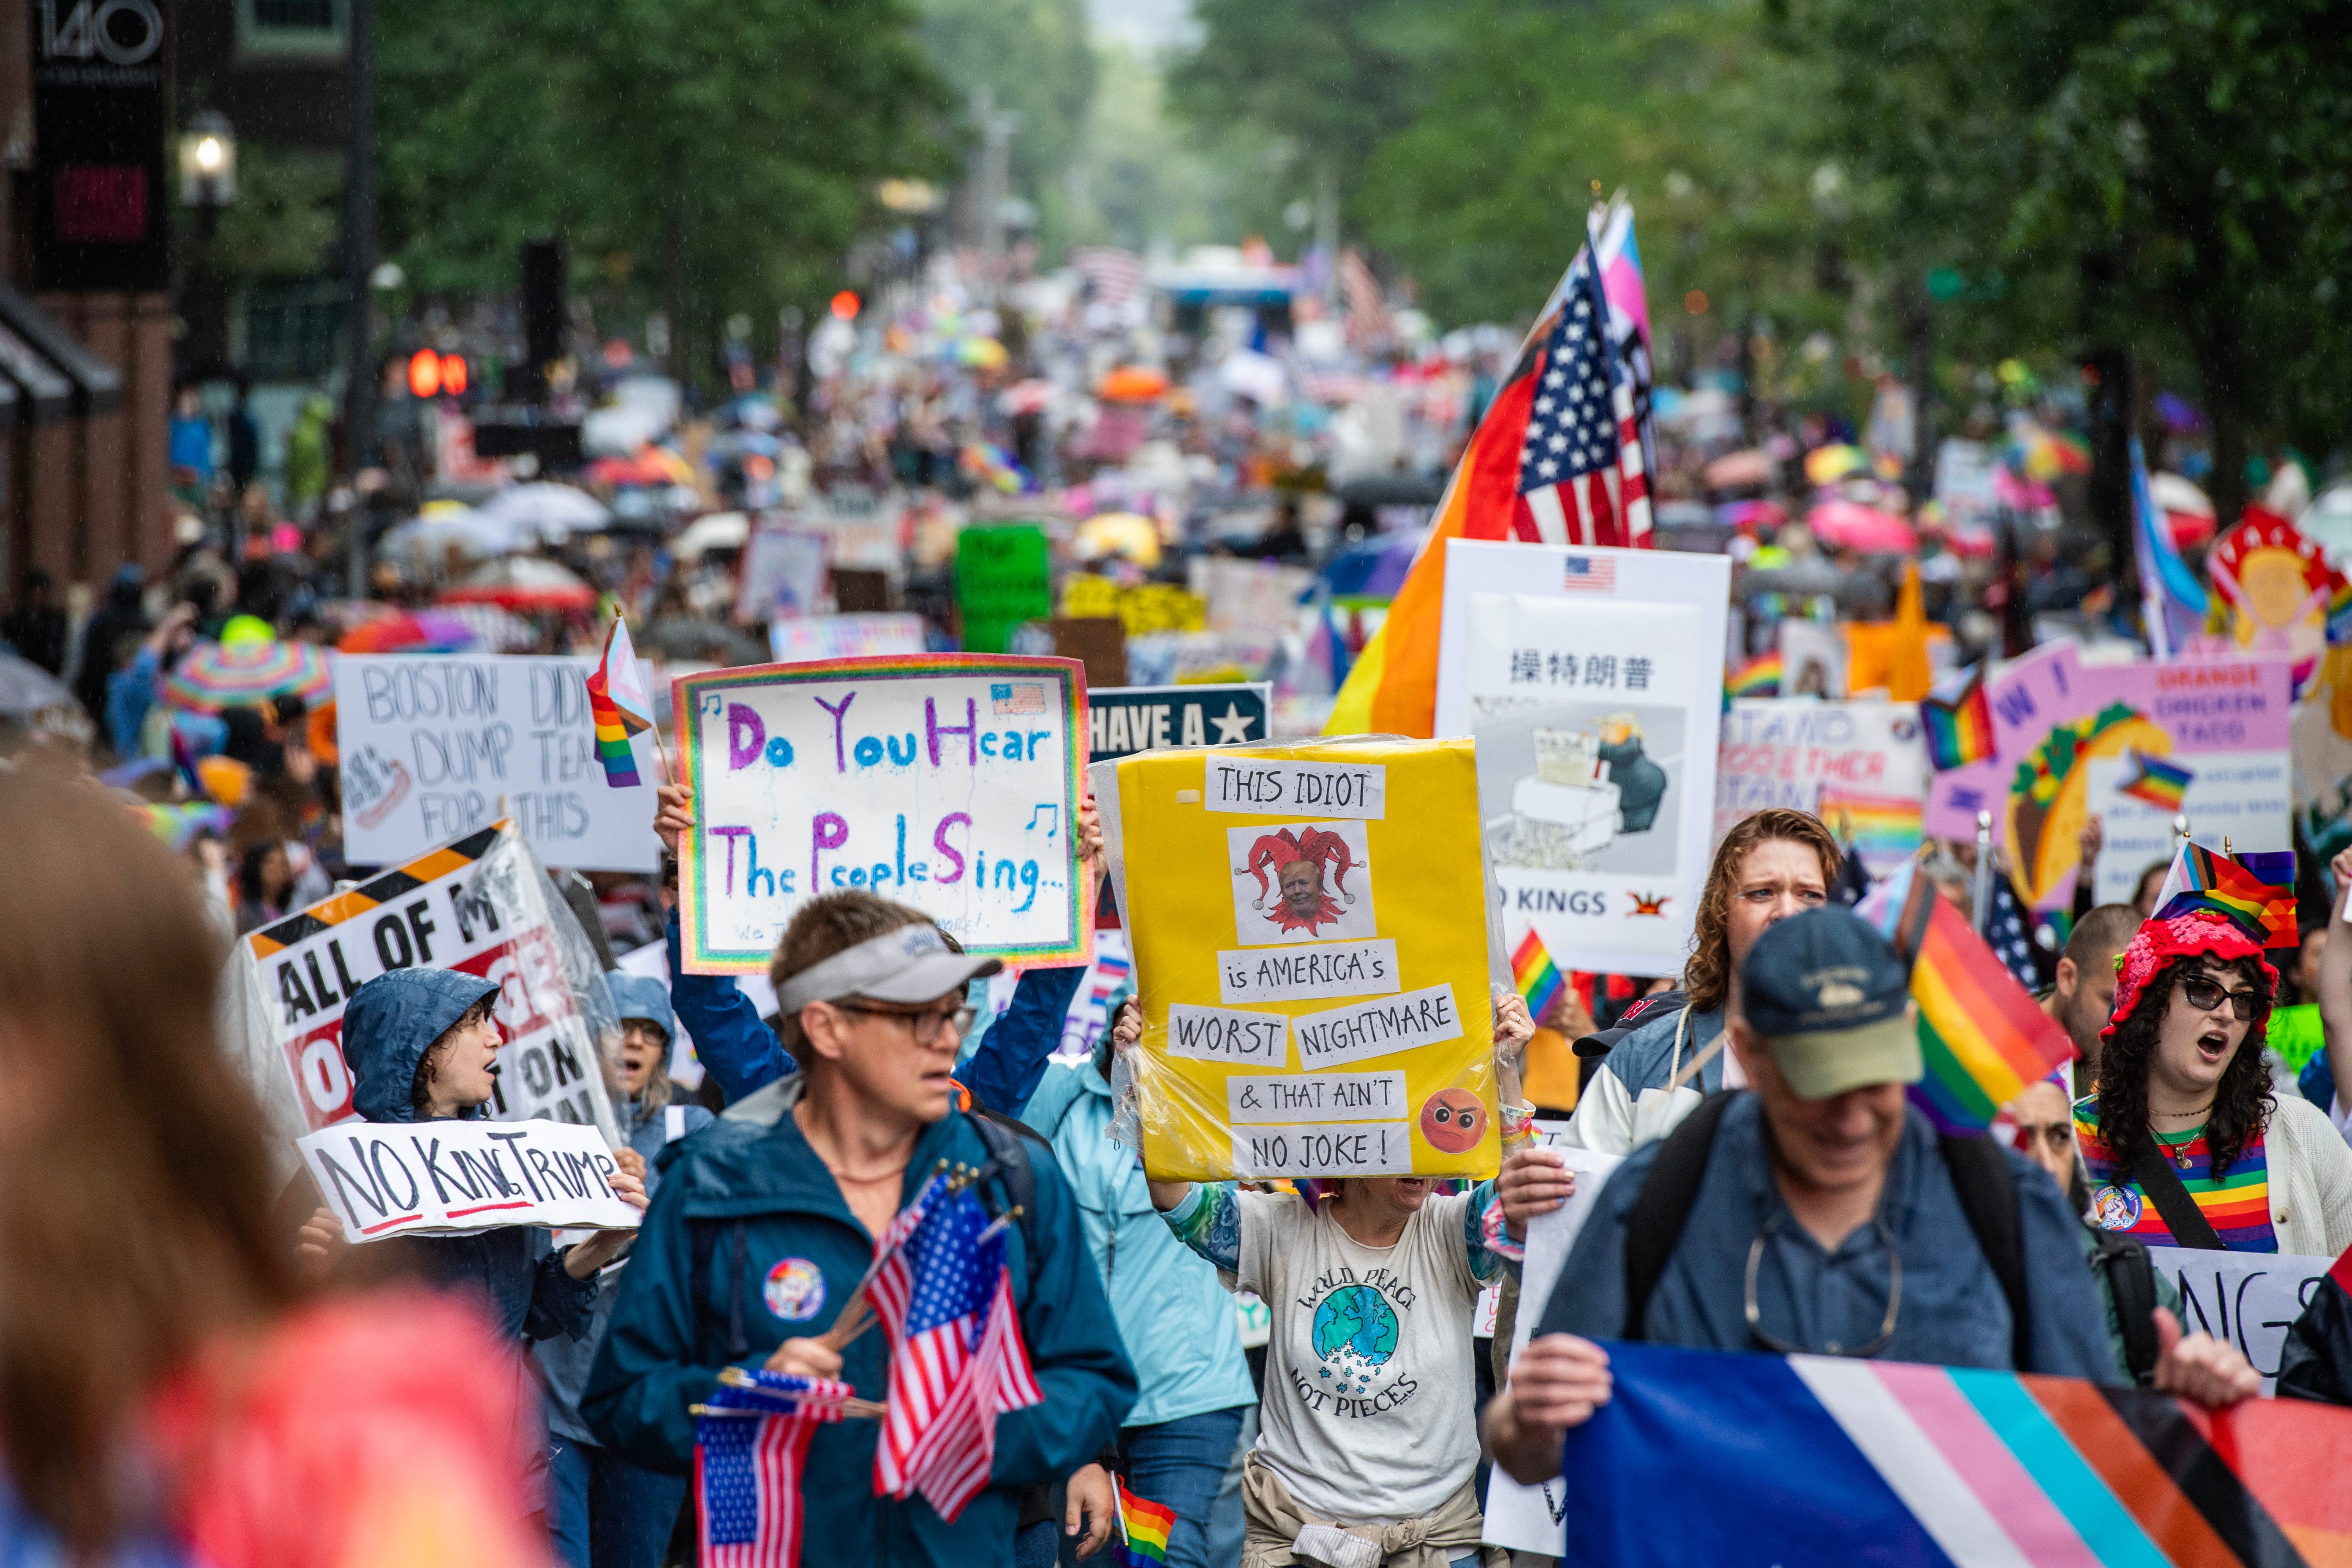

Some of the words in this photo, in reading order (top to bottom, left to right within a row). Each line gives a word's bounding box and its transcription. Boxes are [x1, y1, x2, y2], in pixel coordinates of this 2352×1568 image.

[39, 0, 164, 65] 140
[362, 661, 498, 724] BOSTON
[727, 703, 794, 770] Do
[813, 691, 917, 774] You
[925, 696, 1052, 767] Hear
[1089, 704, 1171, 753] HAVE
[1183, 703, 1206, 745] A
[411, 721, 514, 787] DUMP
[1217, 767, 1283, 803] THIS
[1294, 772, 1369, 808] IDIOT
[422, 790, 487, 841] FOR
[511, 792, 590, 839] THIS
[708, 825, 797, 897] The
[1518, 888, 1607, 915] KINGS
[277, 939, 362, 1026] ALL
[373, 898, 435, 972] OF
[1228, 966, 1247, 988] is
[1258, 949, 1385, 987] AMERICA's
[1176, 1015, 1282, 1056] WORST
[1301, 995, 1451, 1055] NIGHTMARE
[1240, 1084, 1262, 1110] &
[1269, 1082, 1326, 1109] THAT
[1333, 1079, 1393, 1108] AIN'T
[1252, 1138, 1287, 1169] NO
[315, 1136, 418, 1229] NO
[486, 1131, 621, 1202] TRUMP
[2097, 1188, 2114, 1202] POWER
[2105, 1220, 2129, 1228] PEOPLE
[1291, 1367, 1331, 1411] NOT
[1334, 1372, 1417, 1418] PIECES
